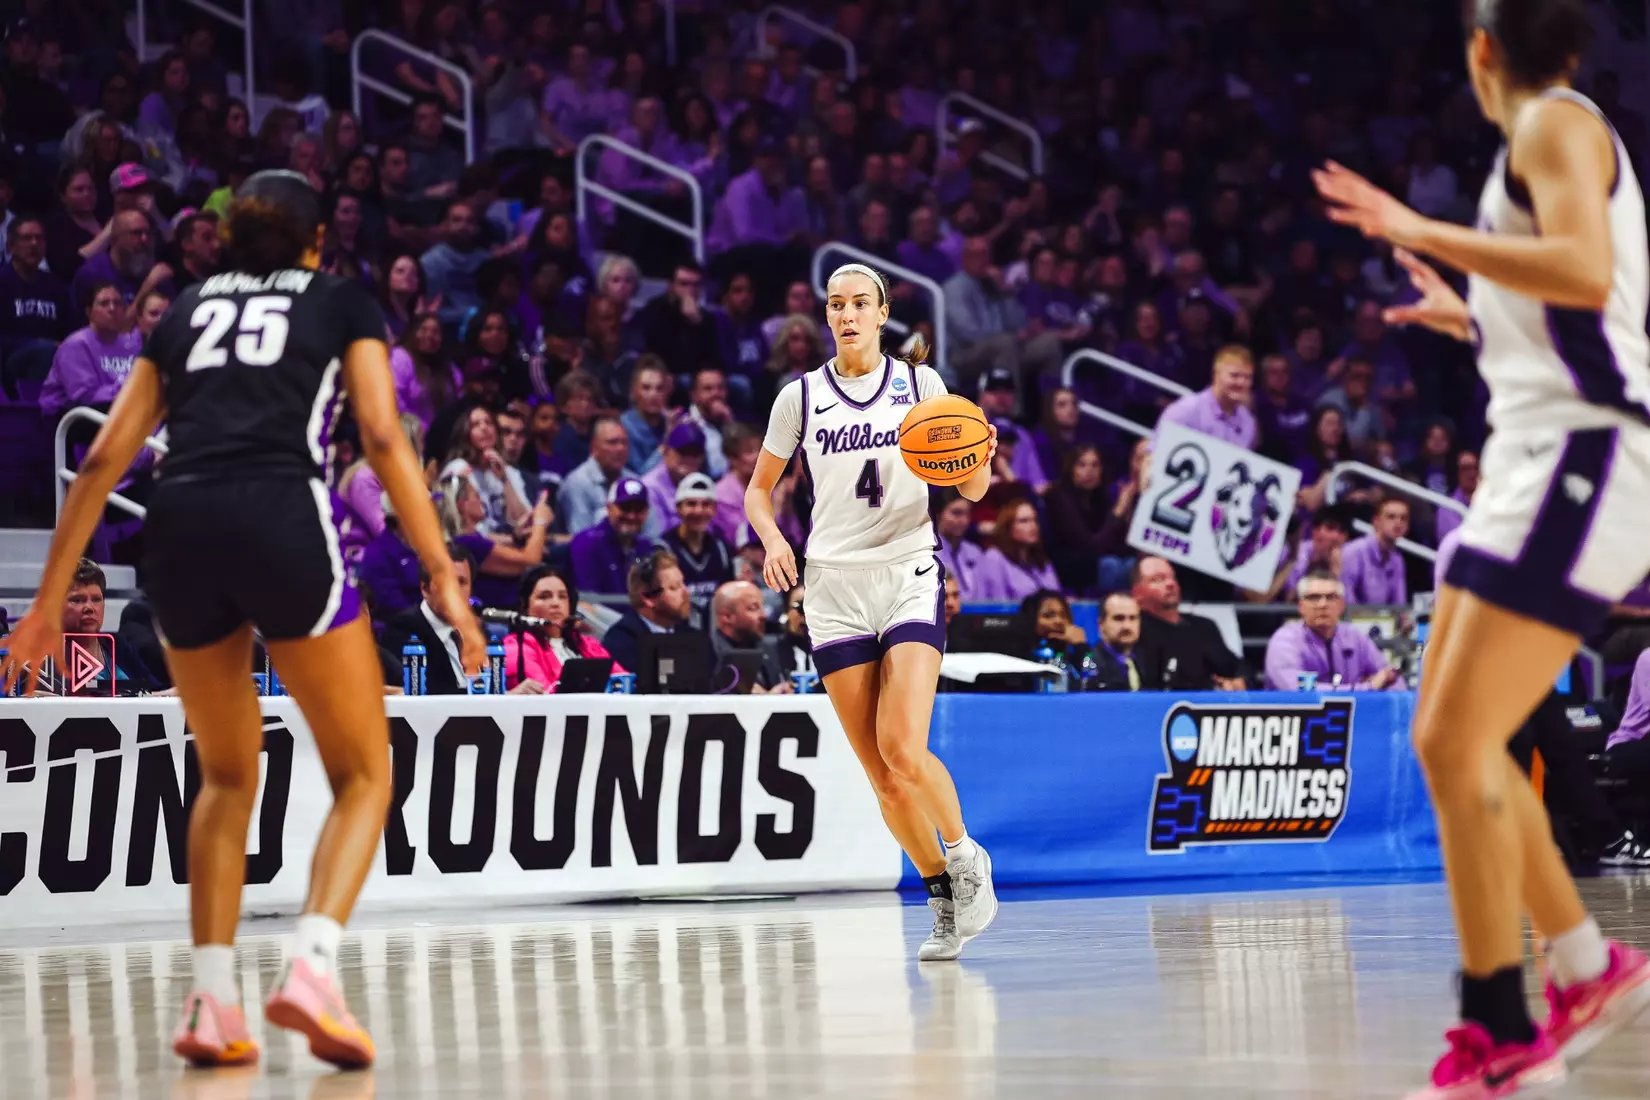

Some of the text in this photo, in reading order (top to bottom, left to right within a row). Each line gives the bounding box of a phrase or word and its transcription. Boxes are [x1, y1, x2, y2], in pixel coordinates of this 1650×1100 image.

[186, 295, 293, 373] 25
[815, 423, 902, 456] Wildca
[918, 452, 978, 473] Wilson
[856, 458, 883, 508] 4
[1151, 443, 1210, 535] 2
[1196, 715, 1301, 767] MARCH
[1209, 767, 1347, 820] MADNESS
